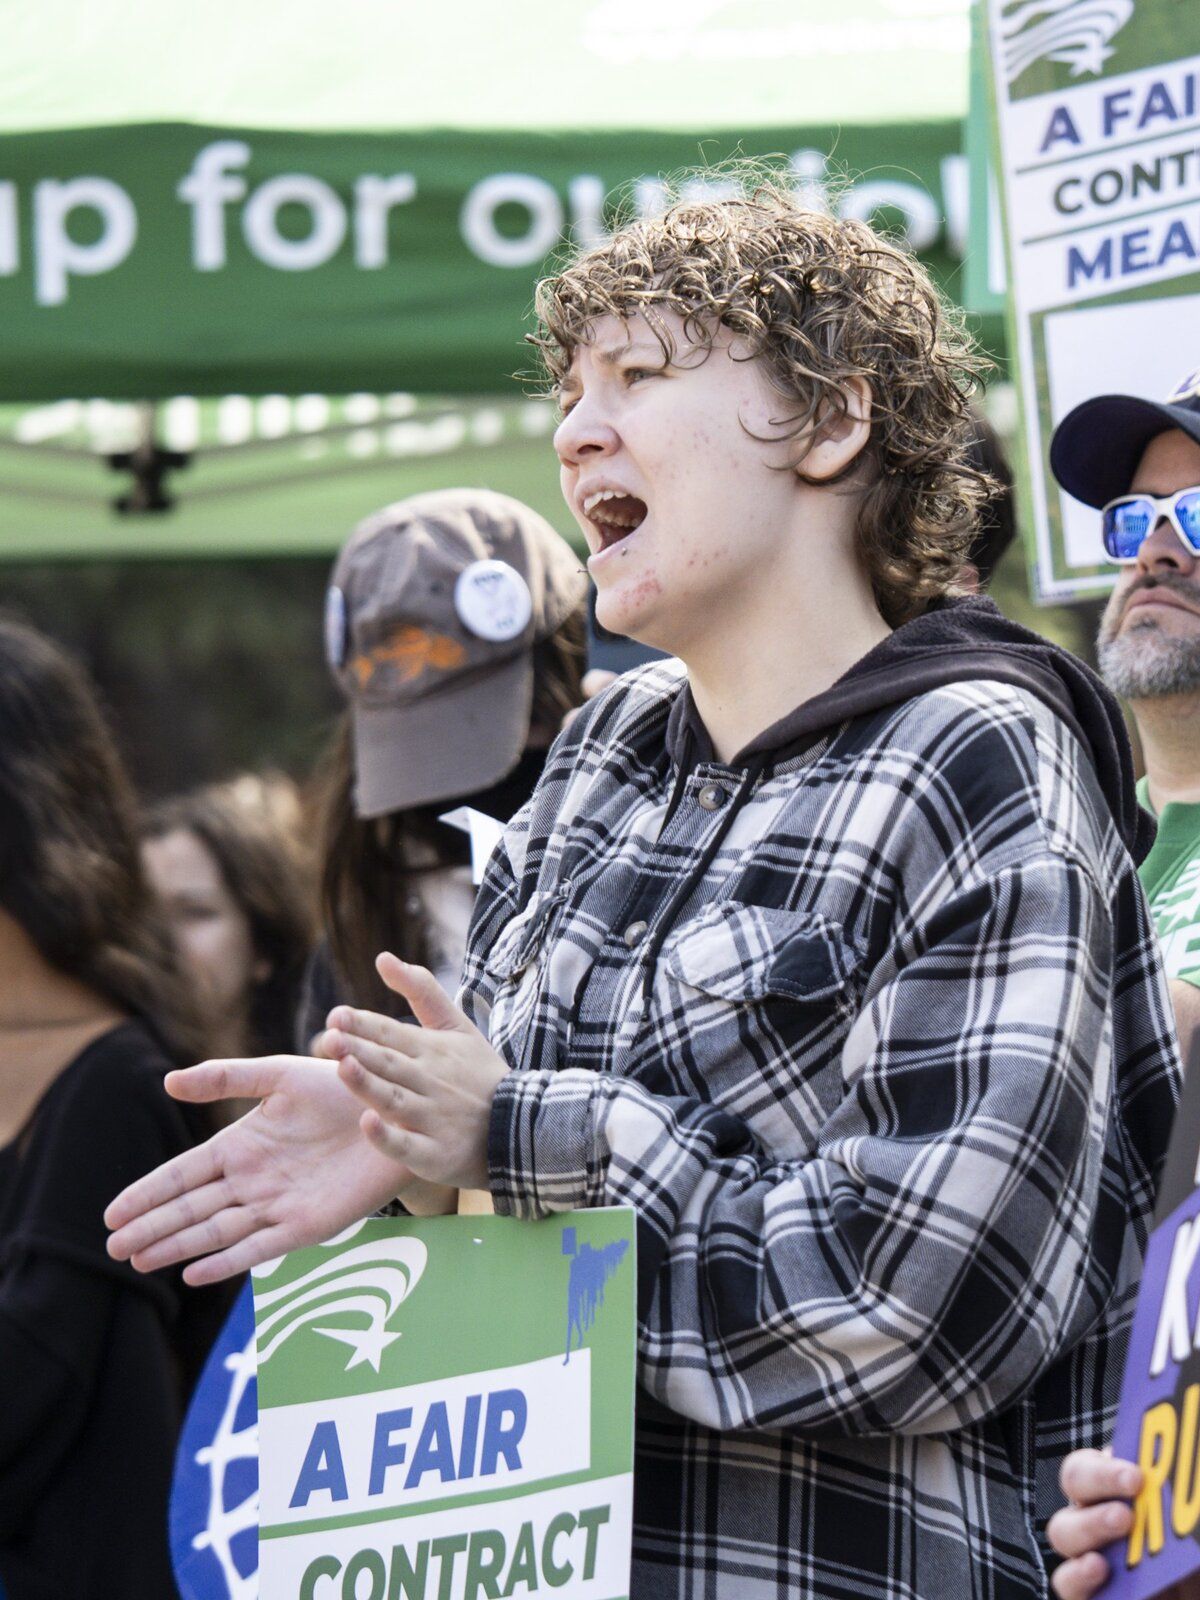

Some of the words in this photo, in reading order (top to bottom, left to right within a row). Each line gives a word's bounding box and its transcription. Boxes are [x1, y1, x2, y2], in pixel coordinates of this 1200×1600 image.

[1039, 106, 1083, 153] A
[177, 140, 417, 271] for
[289, 1420, 349, 1508] A
[368, 1388, 528, 1496] FAIR
[300, 1504, 611, 1600] CONTRACT
